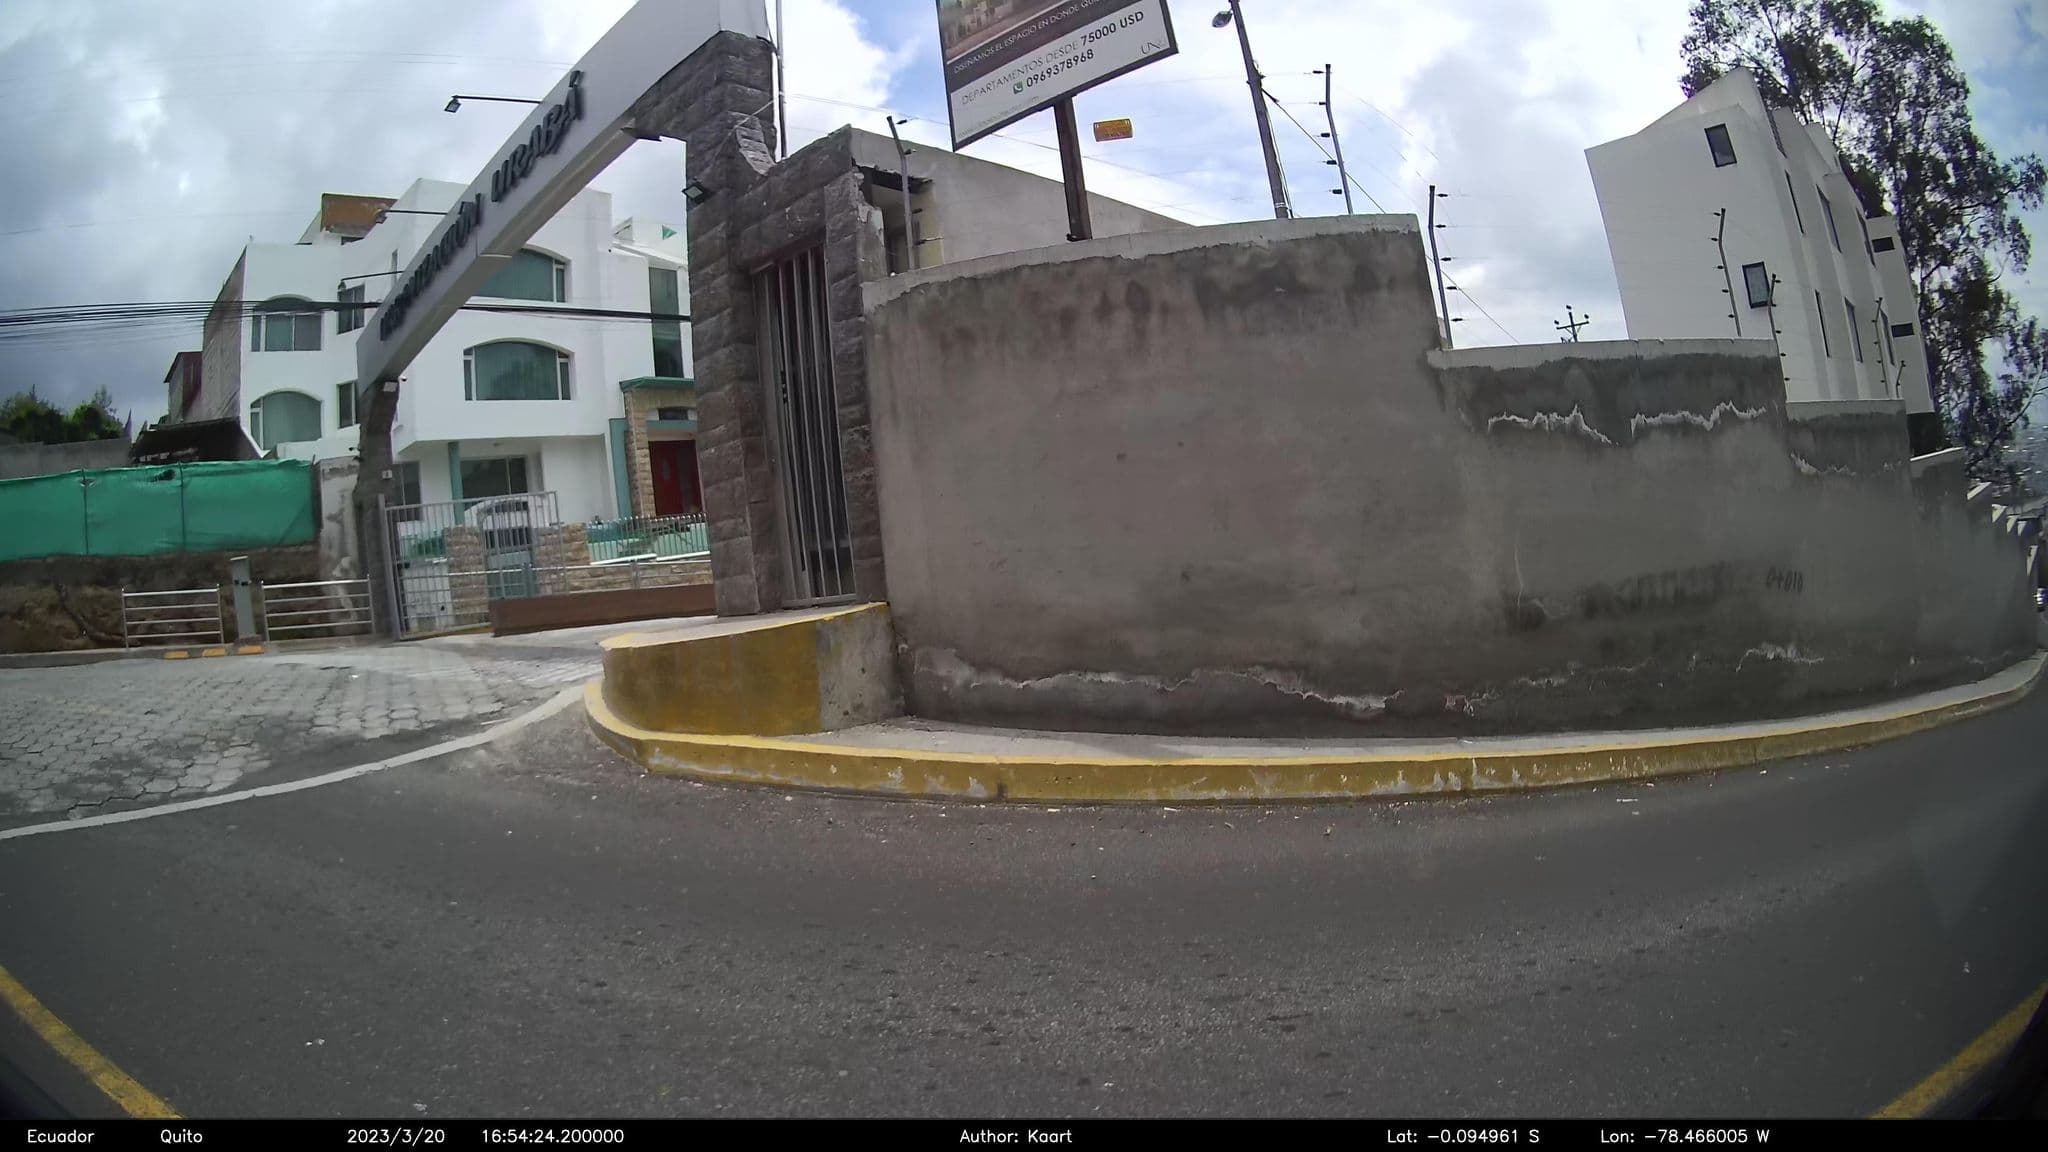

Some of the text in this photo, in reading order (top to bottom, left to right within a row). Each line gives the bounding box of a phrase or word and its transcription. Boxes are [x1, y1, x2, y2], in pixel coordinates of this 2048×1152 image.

[1004, 25, 1037, 47] ESPACIO
[1038, 18, 1050, 29] EN
[1050, 5, 1080, 23] DONDE
[962, 11, 1144, 105] DEPARTAMENTOS DESDE 75000 USD
[1026, 49, 1095, 88] 0969378968
